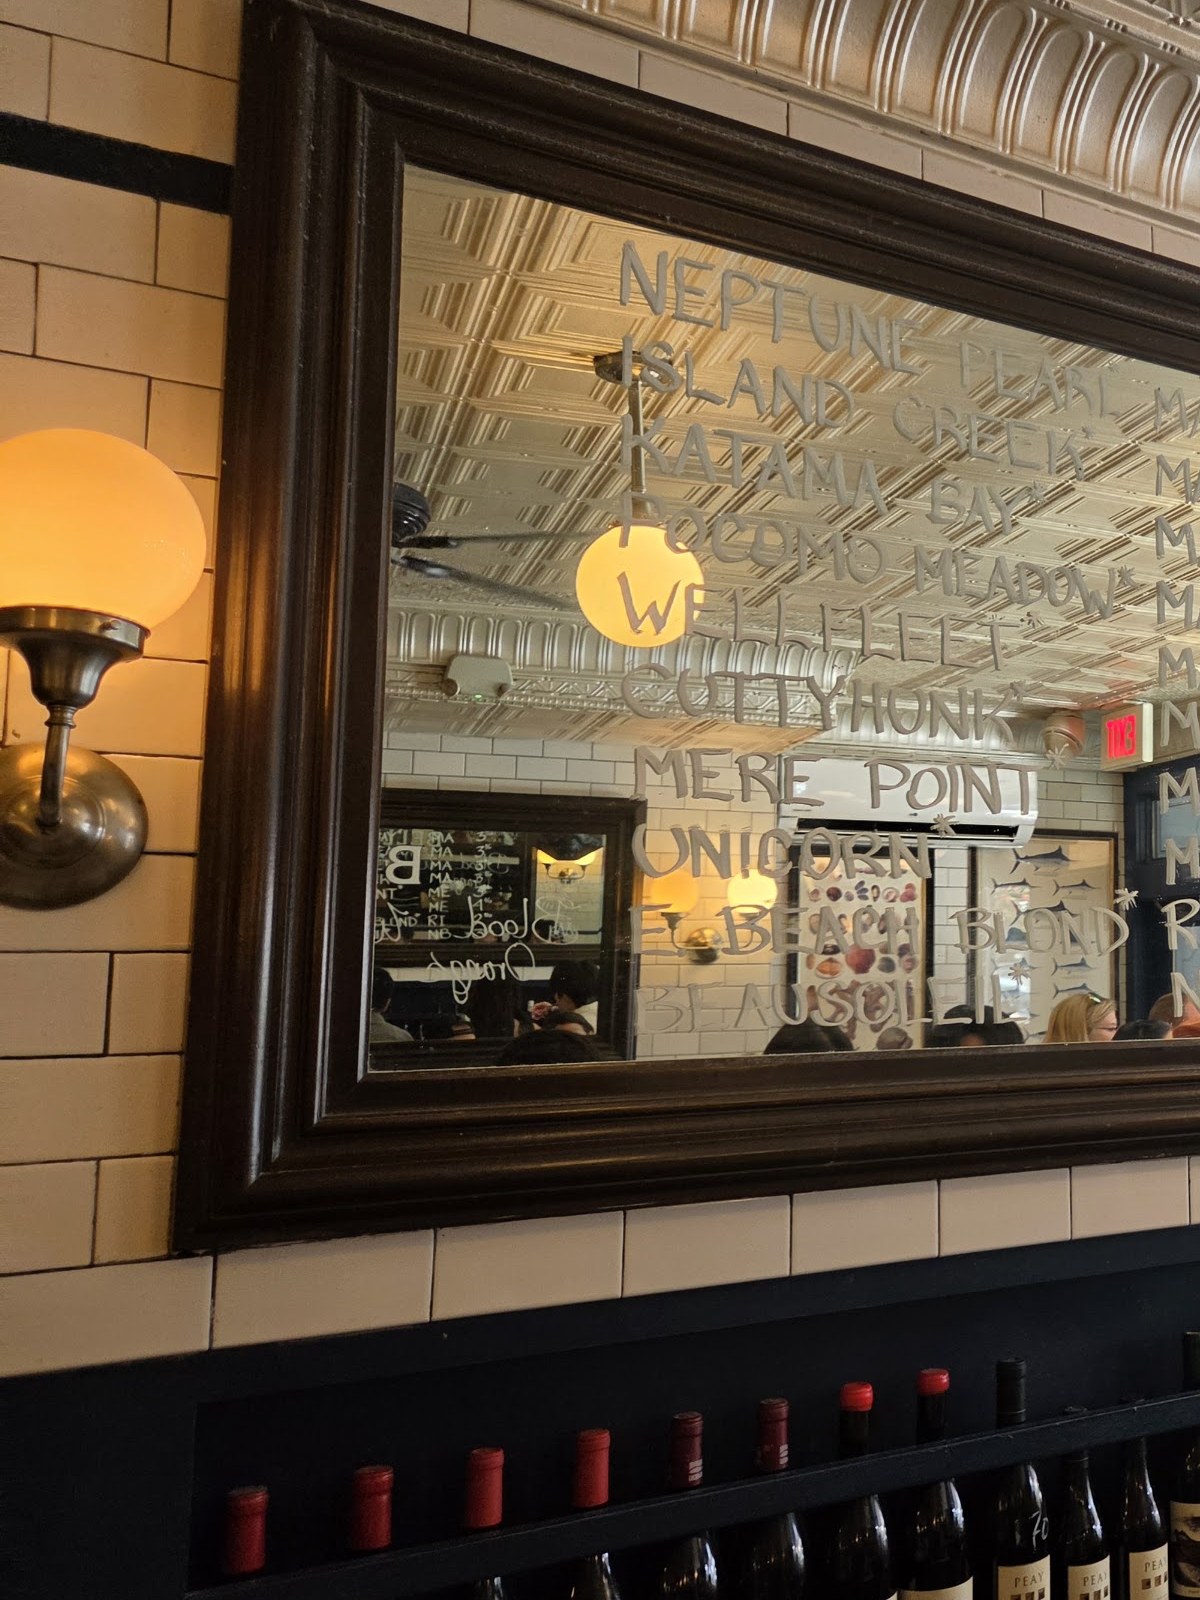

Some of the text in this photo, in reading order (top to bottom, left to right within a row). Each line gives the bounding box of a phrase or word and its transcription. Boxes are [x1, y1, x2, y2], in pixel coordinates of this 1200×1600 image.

[620, 239, 922, 375] NEPTUNE
[621, 335, 856, 428] ISLAND
[620, 413, 887, 515] KATAMA
[619, 491, 887, 584] POCOMO
[632, 747, 825, 806] MERE
[629, 904, 686, 957] E
[716, 904, 920, 957] BEACH
[1014, 1571, 1045, 1588] PEAY
